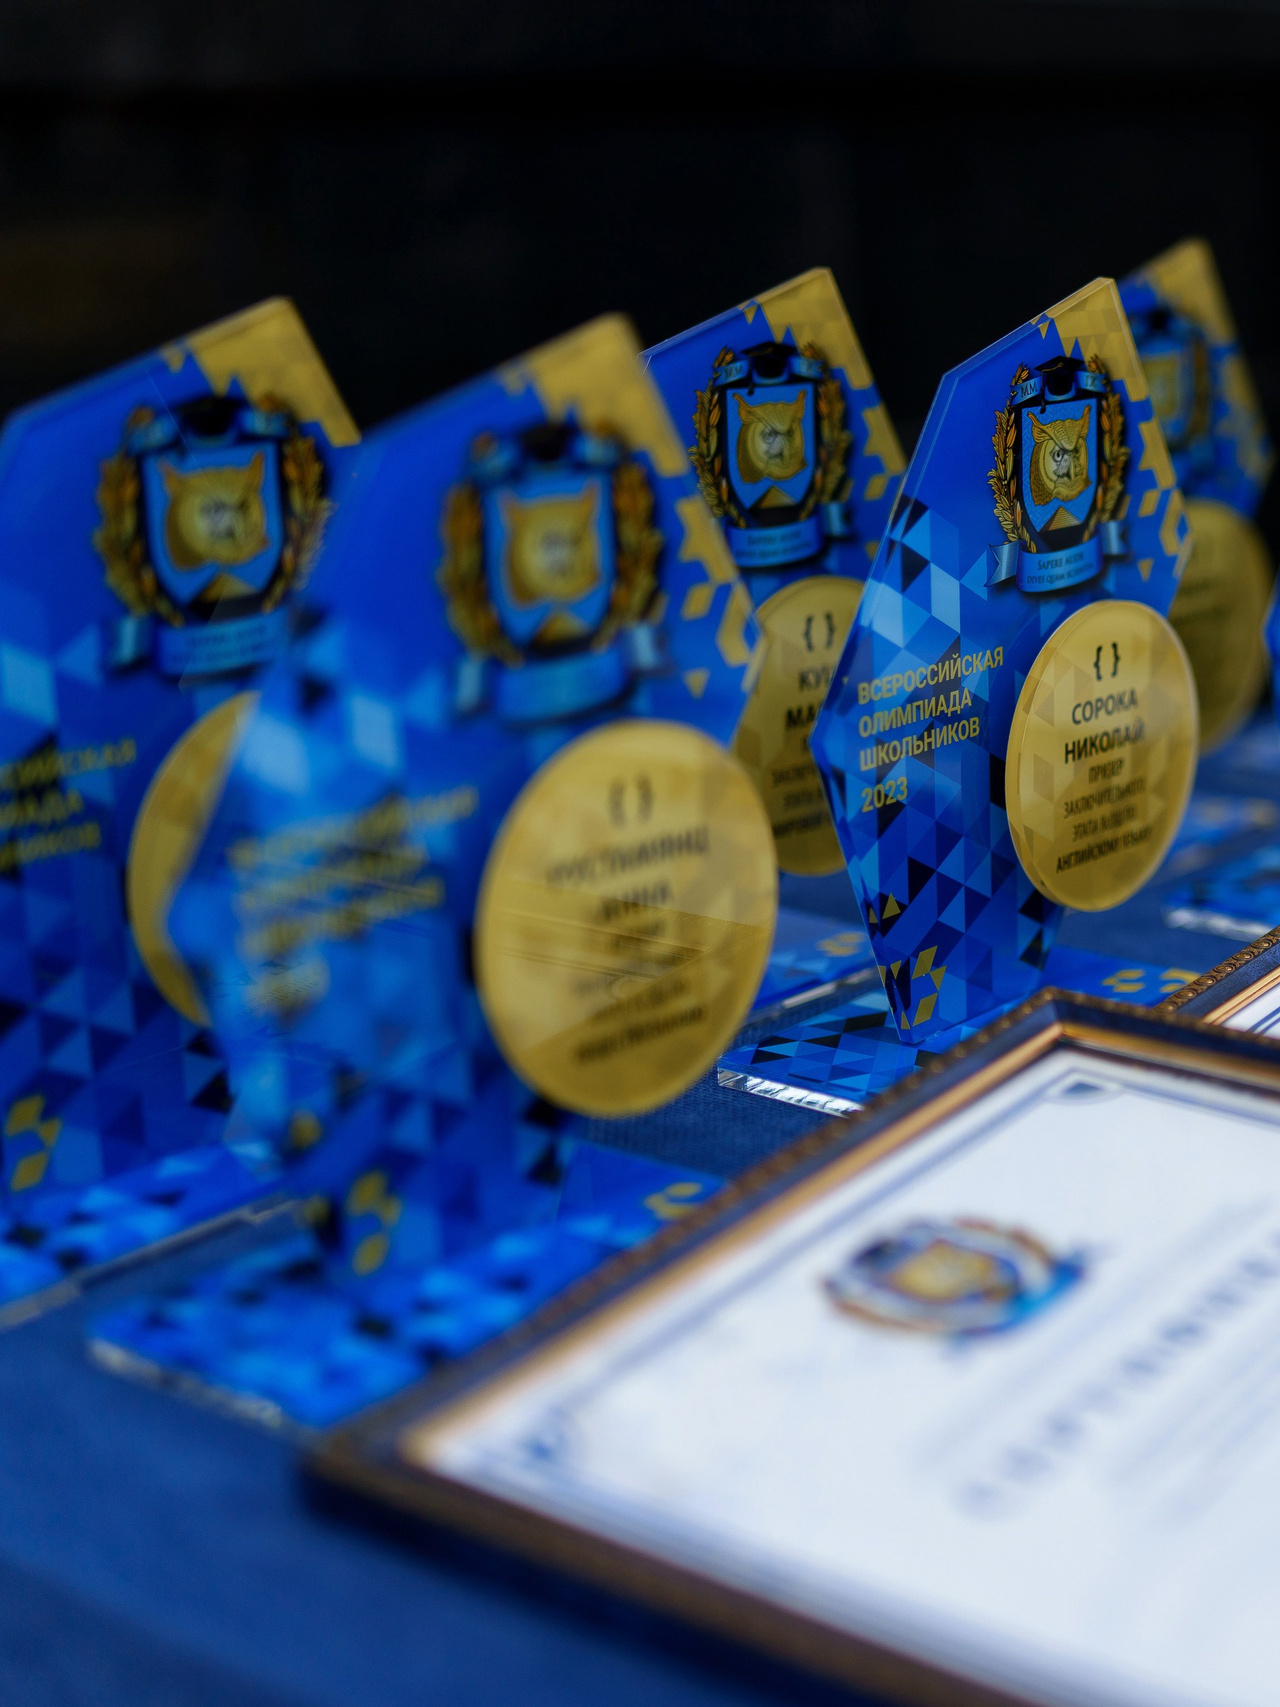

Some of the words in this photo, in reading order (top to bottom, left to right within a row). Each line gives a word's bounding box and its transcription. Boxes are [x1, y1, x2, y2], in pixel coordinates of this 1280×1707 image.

[1020, 381, 1038, 398] MM
[857, 646, 1003, 705] ВСЕРОССИЙСКАЯ
[858, 687, 972, 738] ОЛИМПИАДА
[1071, 688, 1138, 725] СОРОКА
[859, 716, 980, 771] ШКОЛЬНИКОВ
[1064, 719, 1145, 764] НИКОЛАЙ
[861, 776, 908, 812] 2023
